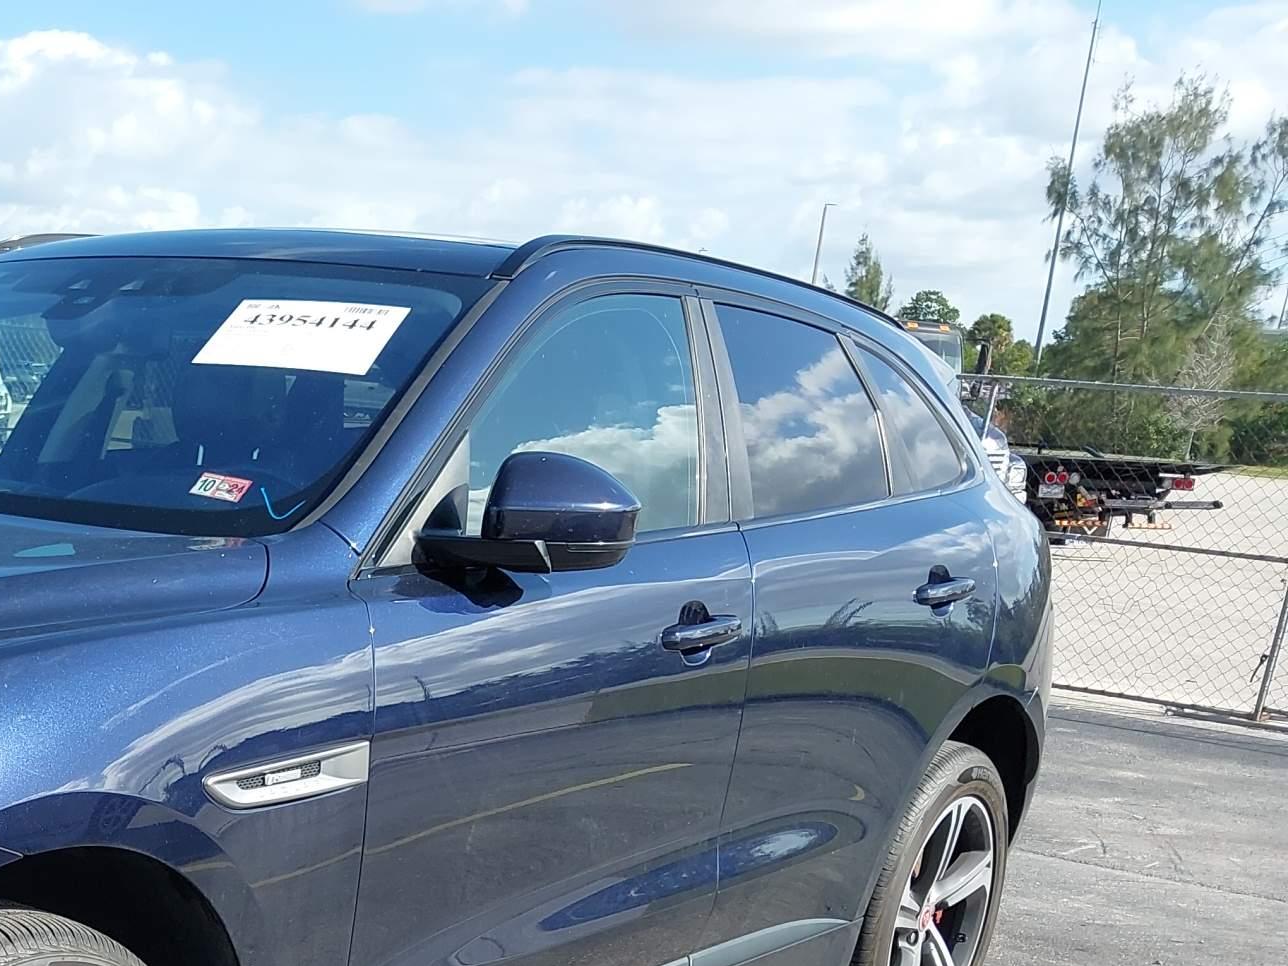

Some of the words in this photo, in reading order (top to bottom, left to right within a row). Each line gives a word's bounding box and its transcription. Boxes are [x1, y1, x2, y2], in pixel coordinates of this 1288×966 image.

[244, 313, 377, 331] 43954144
[198, 478, 216, 492] 10
[227, 483, 245, 494] 24
